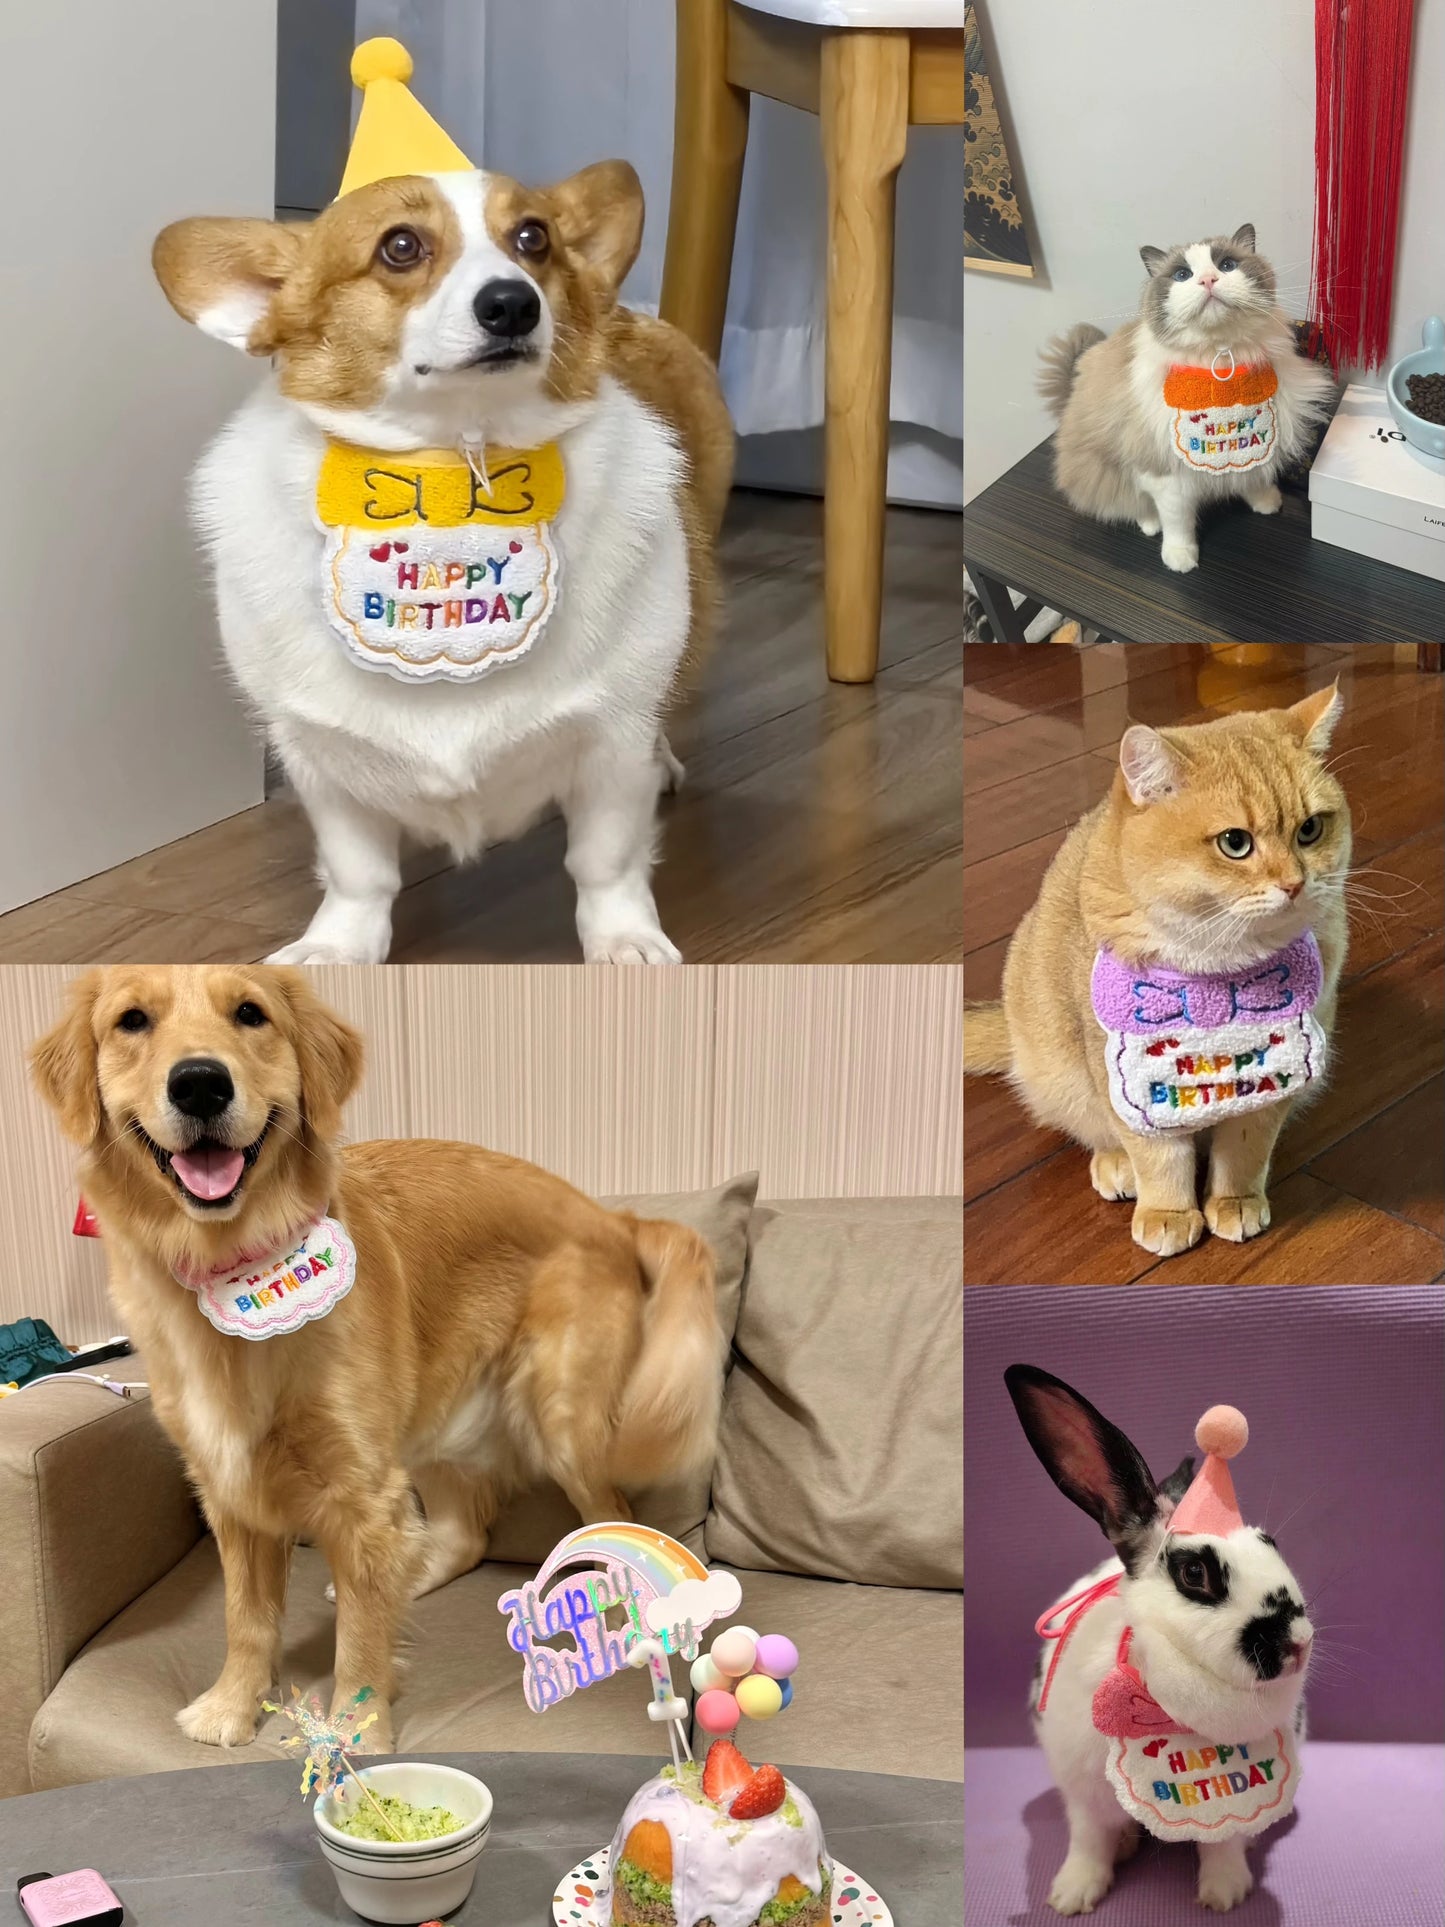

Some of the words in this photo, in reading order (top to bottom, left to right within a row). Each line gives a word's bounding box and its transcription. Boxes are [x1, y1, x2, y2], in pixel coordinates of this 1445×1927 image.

[1190, 429, 1268, 454] BIRTHDAY
[1205, 416, 1257, 436] HAPPY
[397, 556, 511, 590] HAPPY
[364, 591, 532, 630] BIRTHDAY
[1176, 1045, 1272, 1076] HAPPY
[1150, 1072, 1293, 1109] BIRTHDAY
[235, 1247, 333, 1313] BIRTHDAY
[503, 1566, 640, 1650] Happy
[1168, 1743, 1249, 1774] HAPPY
[1152, 1758, 1275, 1807] BIRTHDAY
